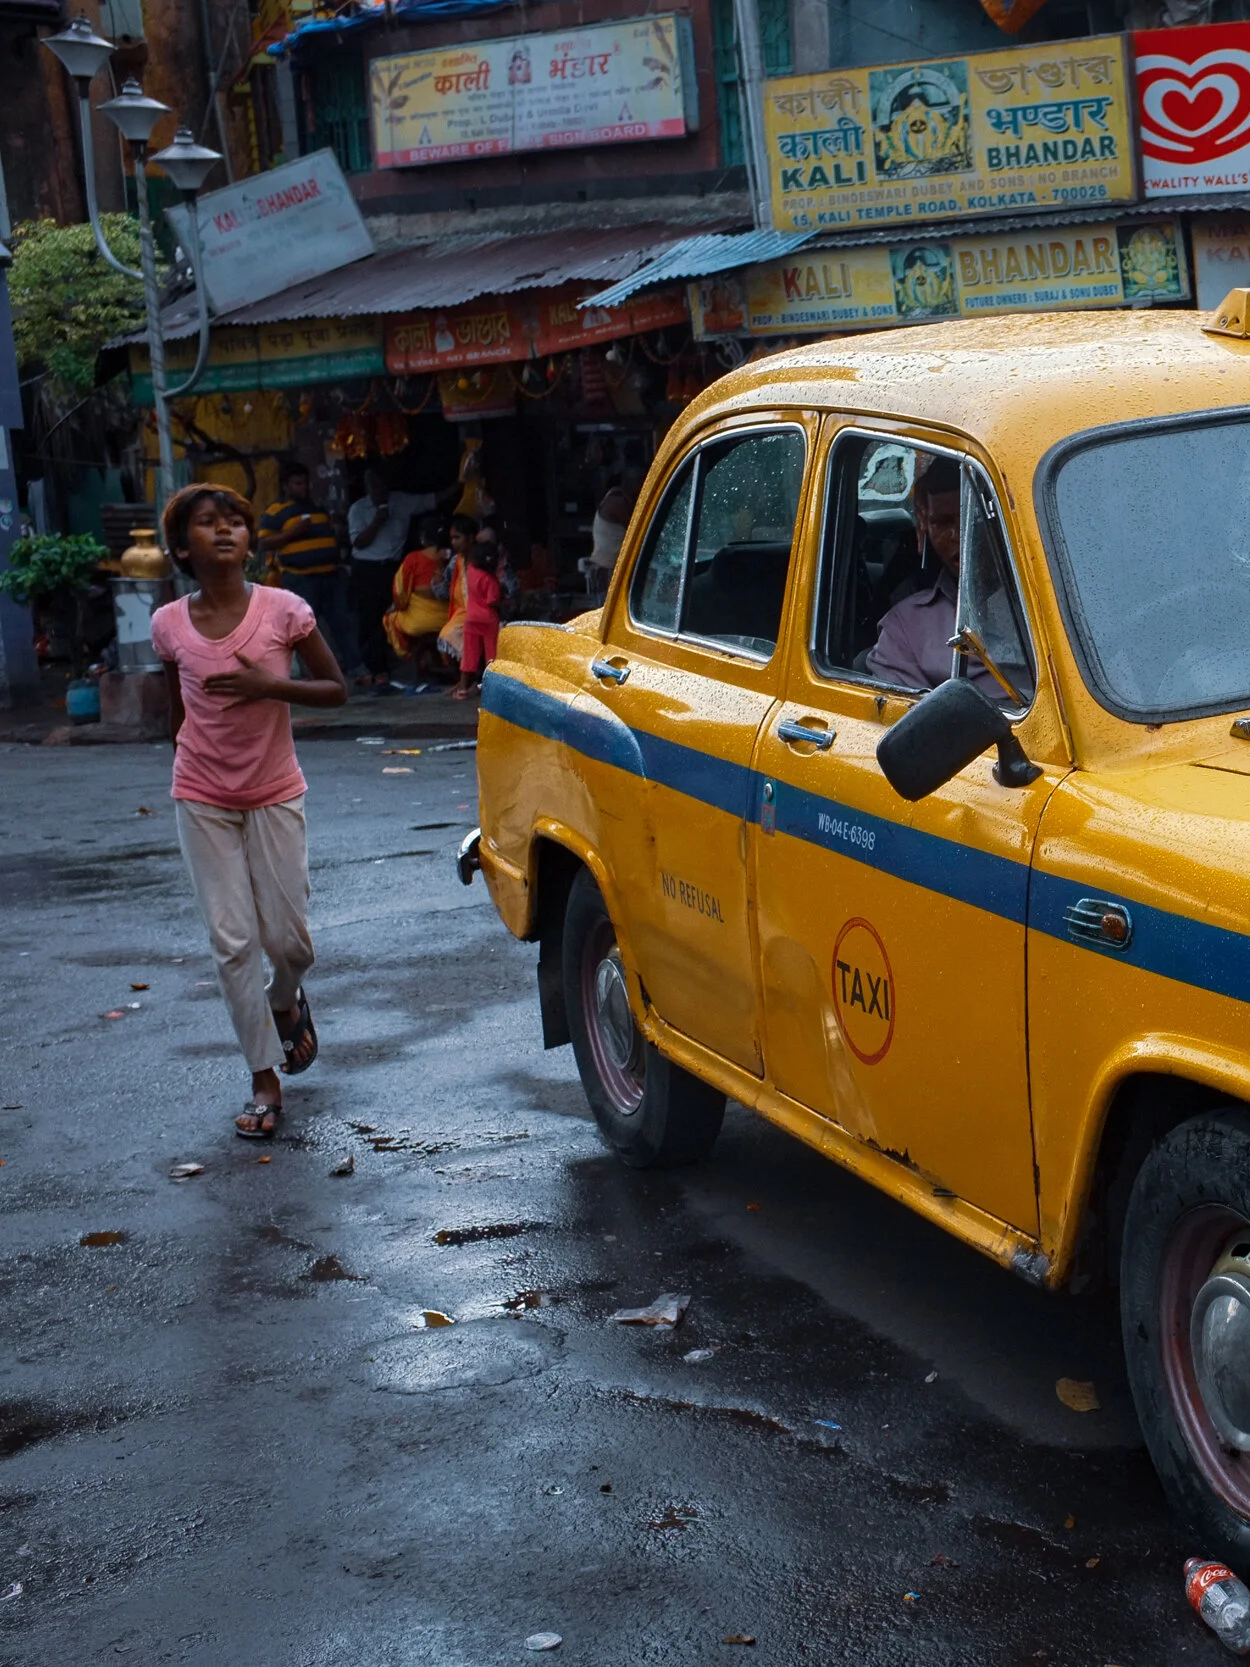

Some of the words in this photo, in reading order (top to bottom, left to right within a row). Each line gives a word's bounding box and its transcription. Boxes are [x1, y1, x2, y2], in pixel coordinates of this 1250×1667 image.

[590, 123, 646, 142] BOARD
[777, 117, 864, 162] काली
[986, 96, 1114, 140] भण्डार
[409, 142, 470, 162] BEWARE
[474, 142, 494, 156] OF
[781, 160, 868, 192] KALI
[986, 135, 1118, 172] BHANDAR
[255, 178, 323, 219] BHANDAR
[911, 182, 953, 197] DUBEY
[959, 178, 985, 193] AND
[990, 174, 1025, 189] SONS
[1038, 171, 1057, 184] NO
[1062, 166, 1118, 182] BRANCH
[1203, 172, 1249, 186] WALL'S
[792, 214, 813, 228] 15,
[817, 210, 852, 224] KALI
[856, 204, 913, 221] TEMPLE
[918, 198, 963, 216] ROAD,
[967, 192, 1037, 209] KOLKATA
[1052, 184, 1108, 201] 700026
[782, 262, 852, 301] KALI
[957, 237, 1117, 287] BHANDAR
[832, 306, 859, 320] DUBEY
[871, 304, 894, 317] SONS
[964, 295, 994, 308] FUTURE
[1093, 283, 1120, 297] DUBEY
[661, 872, 677, 900] NO
[680, 880, 725, 924] REFUSAL
[836, 960, 891, 1022] TAXI
